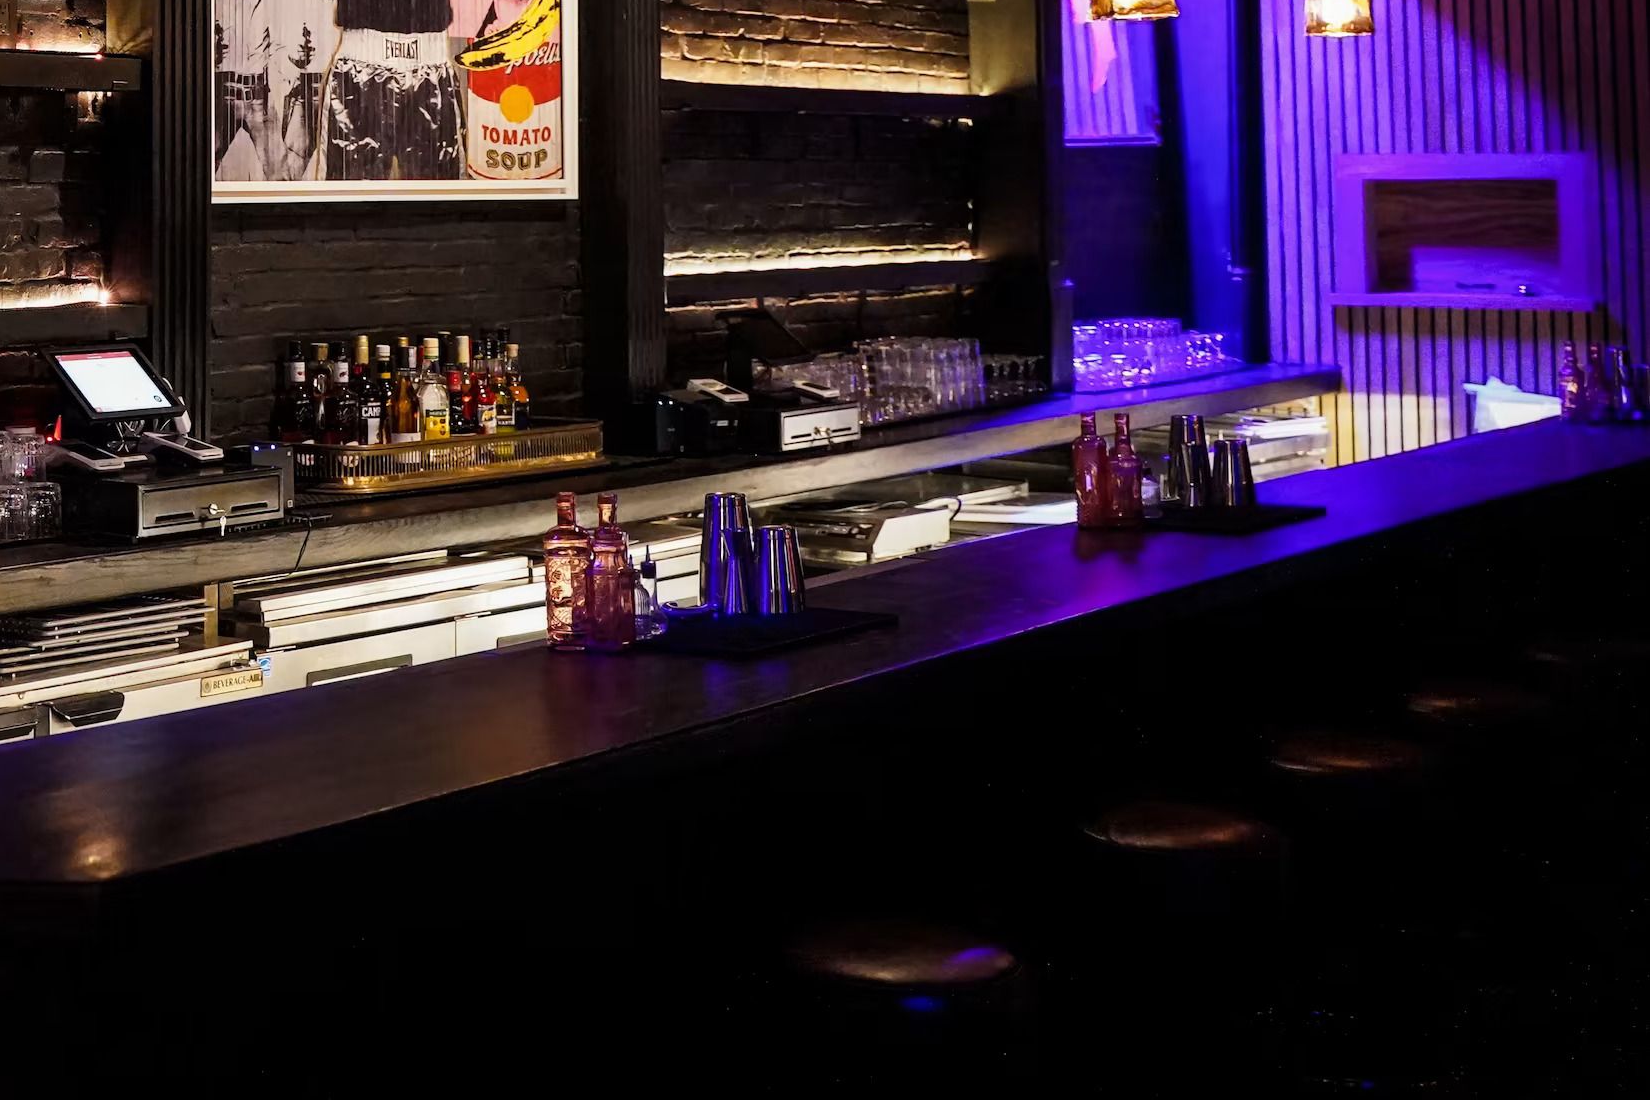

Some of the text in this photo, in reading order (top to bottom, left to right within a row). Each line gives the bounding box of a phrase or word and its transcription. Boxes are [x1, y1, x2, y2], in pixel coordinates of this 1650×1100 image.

[385, 38, 418, 61] EVERLAST
[481, 125, 552, 146] TOMATO
[485, 149, 548, 170] SOUP
